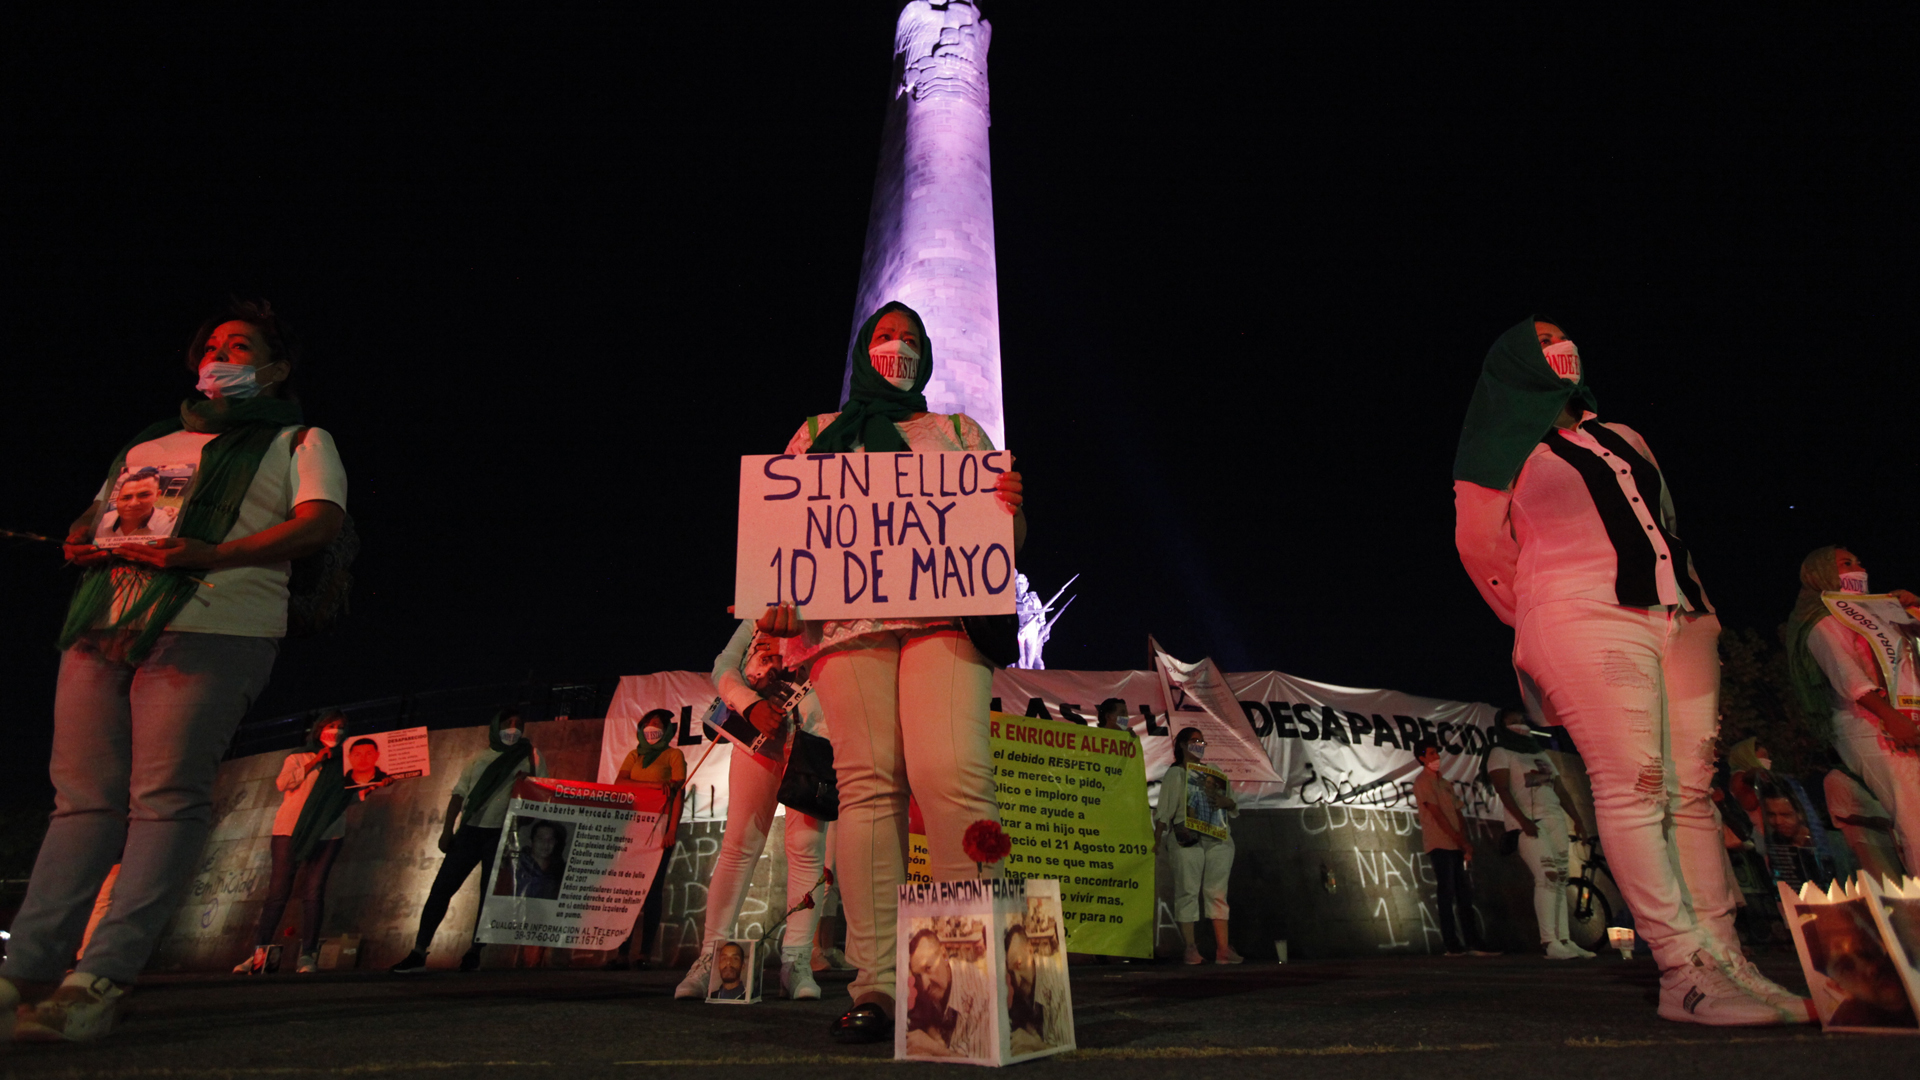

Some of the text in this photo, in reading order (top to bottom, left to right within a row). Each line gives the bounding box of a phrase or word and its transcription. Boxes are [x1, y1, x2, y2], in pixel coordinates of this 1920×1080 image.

[764, 452, 1005, 501] SIN ELLOS
[806, 500, 956, 549] NO HAY
[766, 543, 1011, 606] 10 DE MAYO
[1836, 600, 1878, 631] OSORIO
[1006, 724, 1076, 750] ENRIQUE
[1081, 736, 1136, 758] ALFARO
[994, 749, 1123, 777] el debido RESPETO que
[1001, 768, 1014, 778] se
[1018, 771, 1062, 784] merece
[1065, 774, 1076, 785] le
[1079, 776, 1106, 792] pido,
[554, 784, 635, 804] DESAPARECIDO
[1025, 788, 1032, 796] e
[1035, 787, 1078, 803] imploro
[1081, 793, 1101, 805] que
[521, 801, 540, 811] Juan
[579, 807, 611, 819] Mercado
[1019, 804, 1037, 814] me
[1040, 806, 1075, 819] ayude
[1078, 811, 1085, 820] a
[1025, 821, 1032, 830] a
[1035, 820, 1050, 831] mi
[1053, 823, 1075, 836] hijo
[1078, 827, 1100, 838] que
[1040, 838, 1051, 849] el
[1055, 839, 1069, 850] 21
[1073, 841, 1115, 855] Agosto
[1119, 843, 1148, 855] 2019
[1009, 854, 1114, 869] ya no se que mas
[1004, 868, 1040, 880] hacer
[1074, 875, 1139, 890] encontrarlo
[900, 883, 938, 902] HASTA
[1070, 892, 1094, 903] vivir
[1097, 895, 1124, 906] mas.
[1079, 913, 1106, 924] para
[1109, 914, 1124, 924] no
[514, 930, 560, 943] 38-37-60-00
[530, 922, 579, 934] INFORMACION
